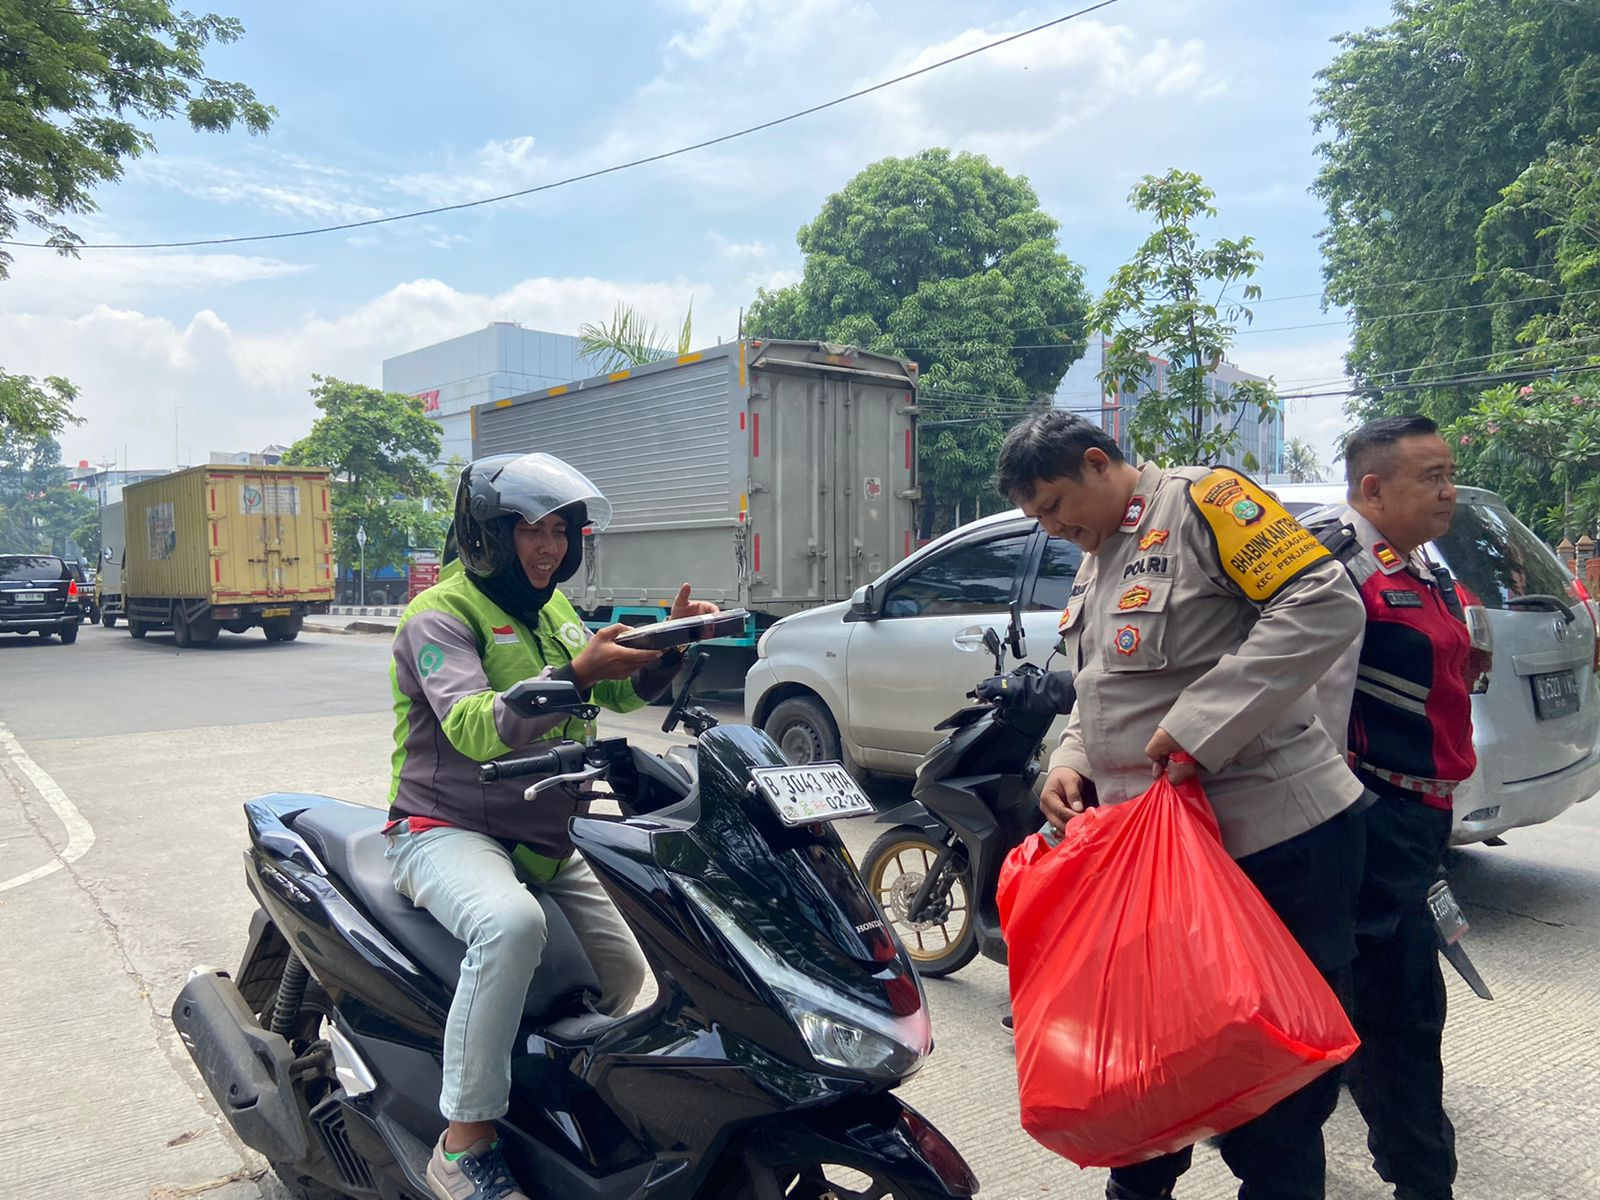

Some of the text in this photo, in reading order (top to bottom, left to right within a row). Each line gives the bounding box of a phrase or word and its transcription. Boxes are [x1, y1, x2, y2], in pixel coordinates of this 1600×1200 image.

[1123, 556, 1168, 579] POLRI
[1252, 560, 1273, 576] KEL.
[1255, 571, 1277, 590] KEC.
[763, 770, 854, 796] B 3043 PMA
[855, 920, 884, 934] HONDA
